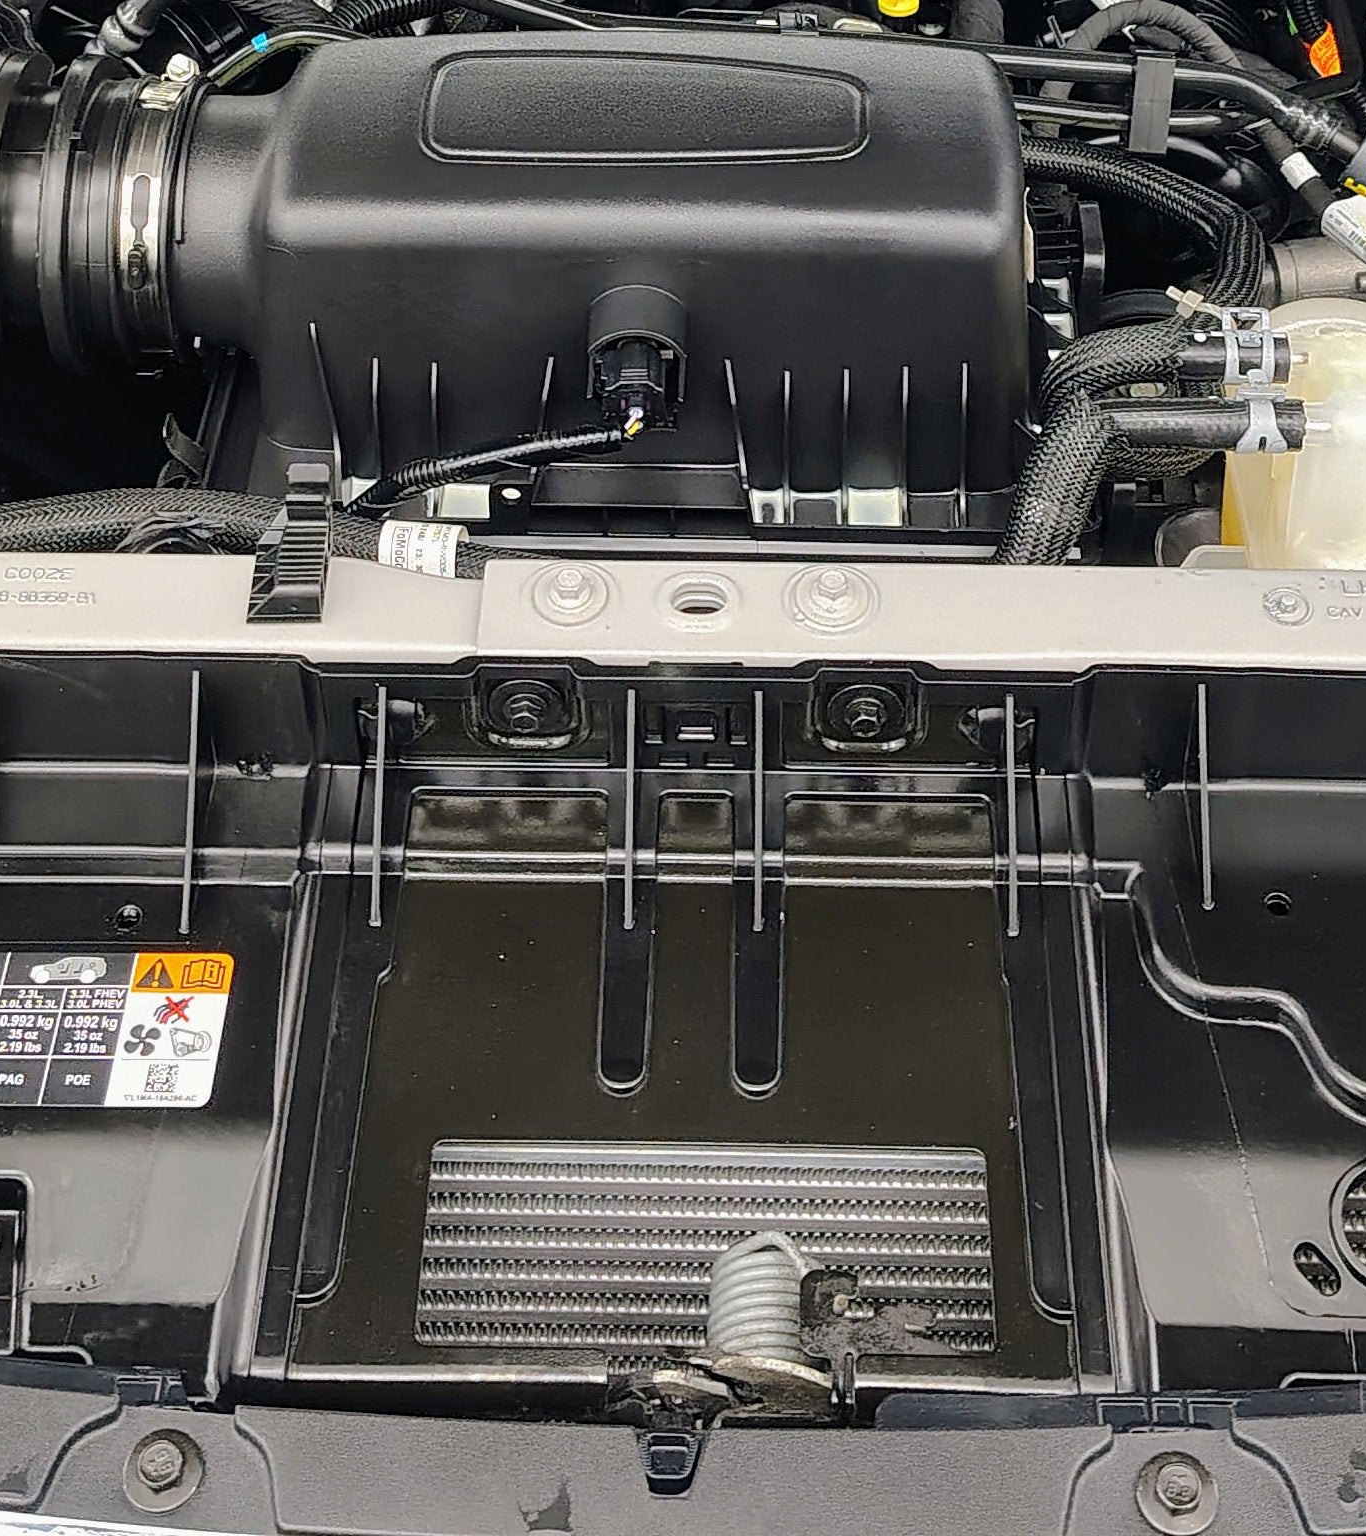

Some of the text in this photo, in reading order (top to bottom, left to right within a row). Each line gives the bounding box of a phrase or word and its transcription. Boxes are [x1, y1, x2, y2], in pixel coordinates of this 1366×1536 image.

[1326, 606, 1362, 619] CAV
[70, 989, 126, 999] 3.3L FHEV
[0, 999, 58, 1008] 3.0L & 3.3L
[66, 999, 124, 1009] 3.0L PHEV
[0, 1015, 55, 1031] 0.992 kg
[64, 1015, 119, 1031] 0.992 kg
[8, 1029, 39, 1040] 35 oz
[73, 1030, 104, 1041] 35 oz
[24, 1042, 42, 1053] lbs
[63, 1043, 107, 1054] 2.19 lbs
[65, 1074, 91, 1085] POE
